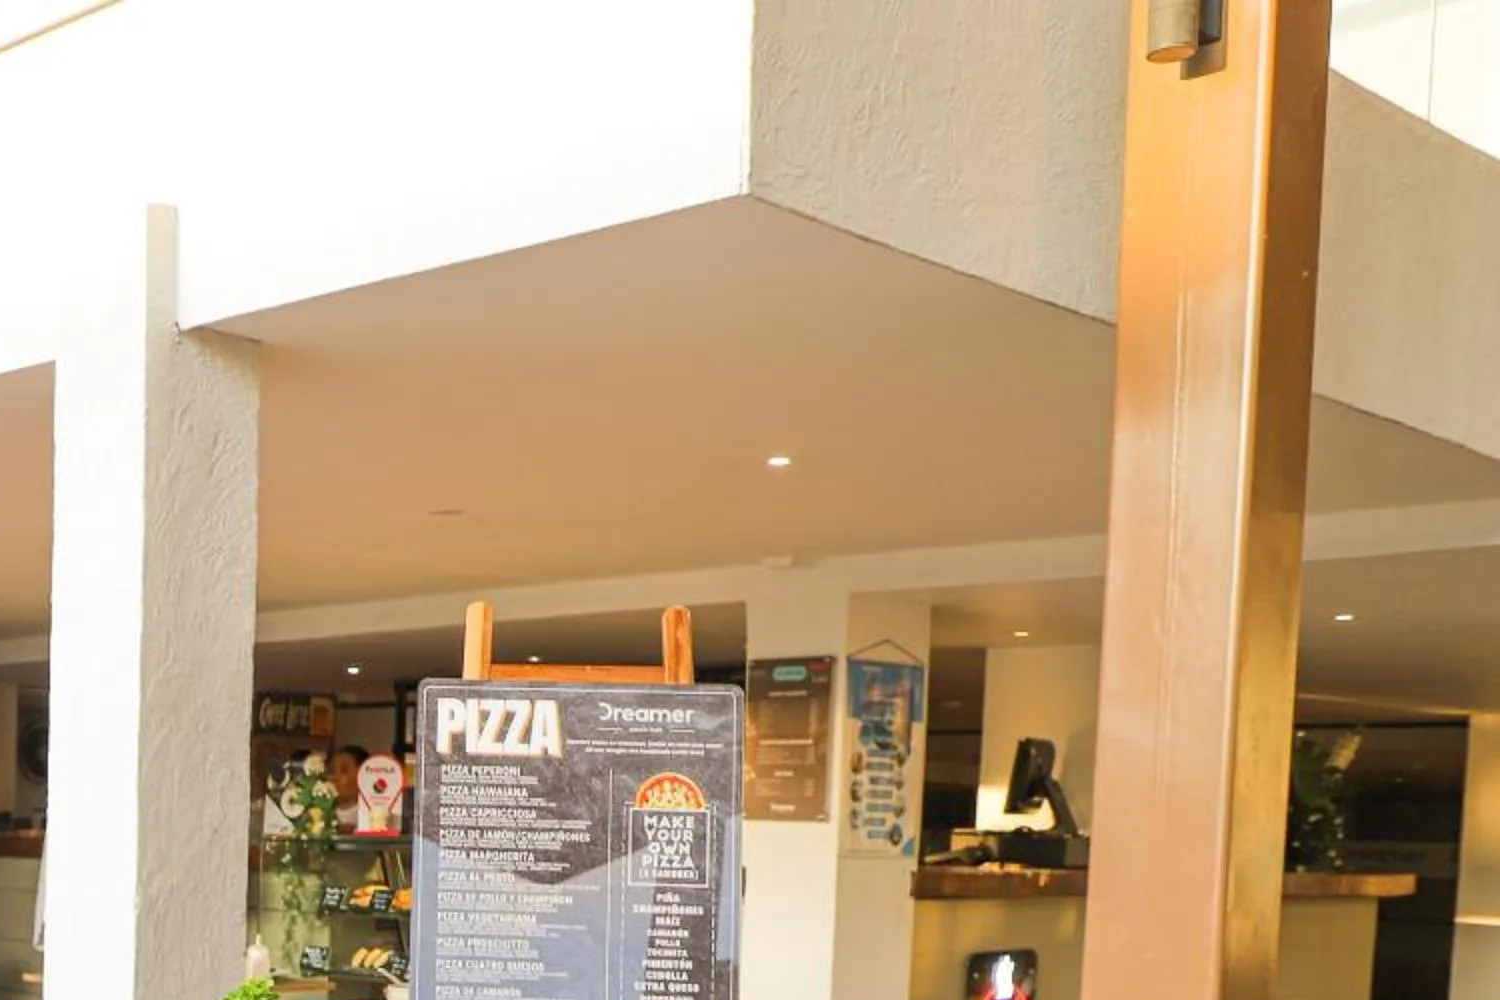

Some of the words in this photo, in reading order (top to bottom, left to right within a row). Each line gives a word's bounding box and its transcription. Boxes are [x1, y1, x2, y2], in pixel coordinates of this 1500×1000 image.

[598, 701, 695, 723] Dreamer
[436, 697, 563, 758] PIZZA
[441, 764, 469, 776] PIZZA
[440, 784, 468, 796] PIZZA
[471, 785, 529, 798] HAWAIANA
[440, 807, 469, 818] PIZZA
[643, 815, 695, 829] MAKE
[440, 828, 465, 840] PIZZA
[644, 828, 694, 842] YOUR
[439, 849, 467, 861] PIZZA
[648, 841, 692, 855] OWN
[641, 854, 695, 869] PIZZA
